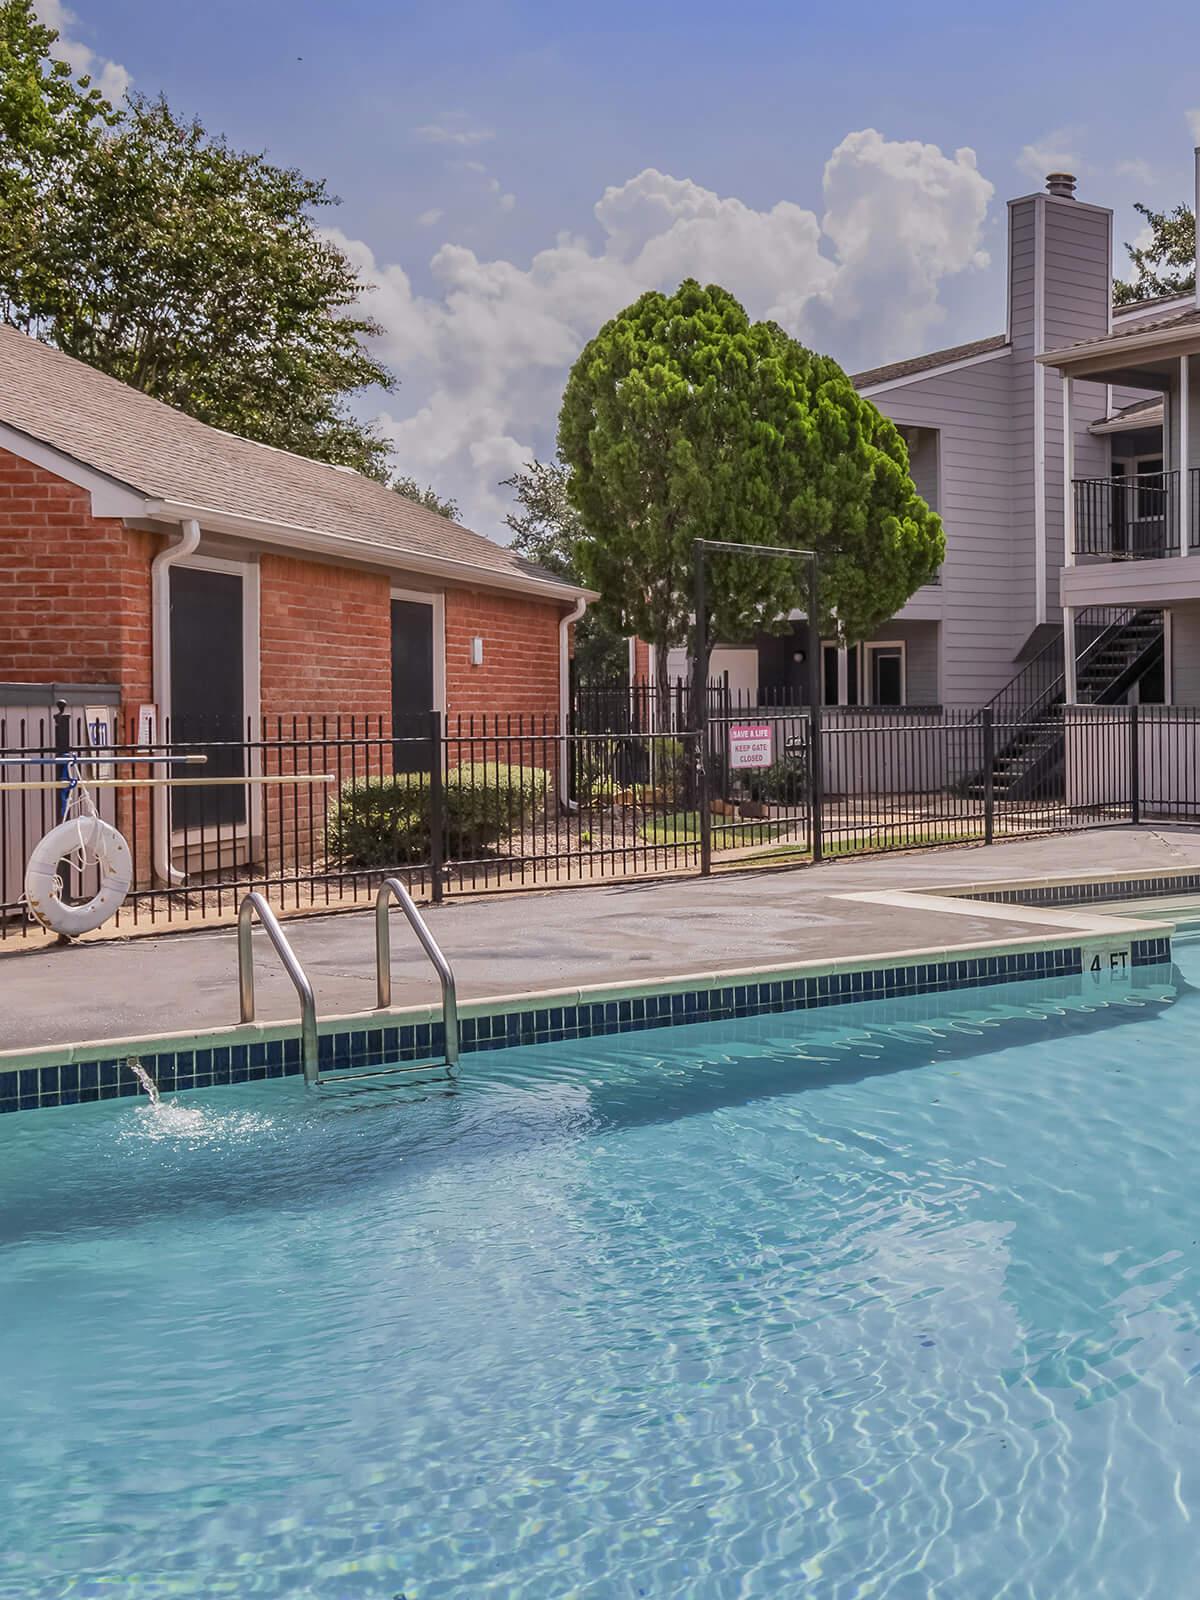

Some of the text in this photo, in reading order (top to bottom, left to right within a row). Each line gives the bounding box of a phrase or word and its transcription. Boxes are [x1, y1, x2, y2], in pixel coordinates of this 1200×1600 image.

[732, 730, 749, 739] SAVE
[756, 729, 769, 738] LIFE
[1090, 952, 1128, 971] 4 FT
